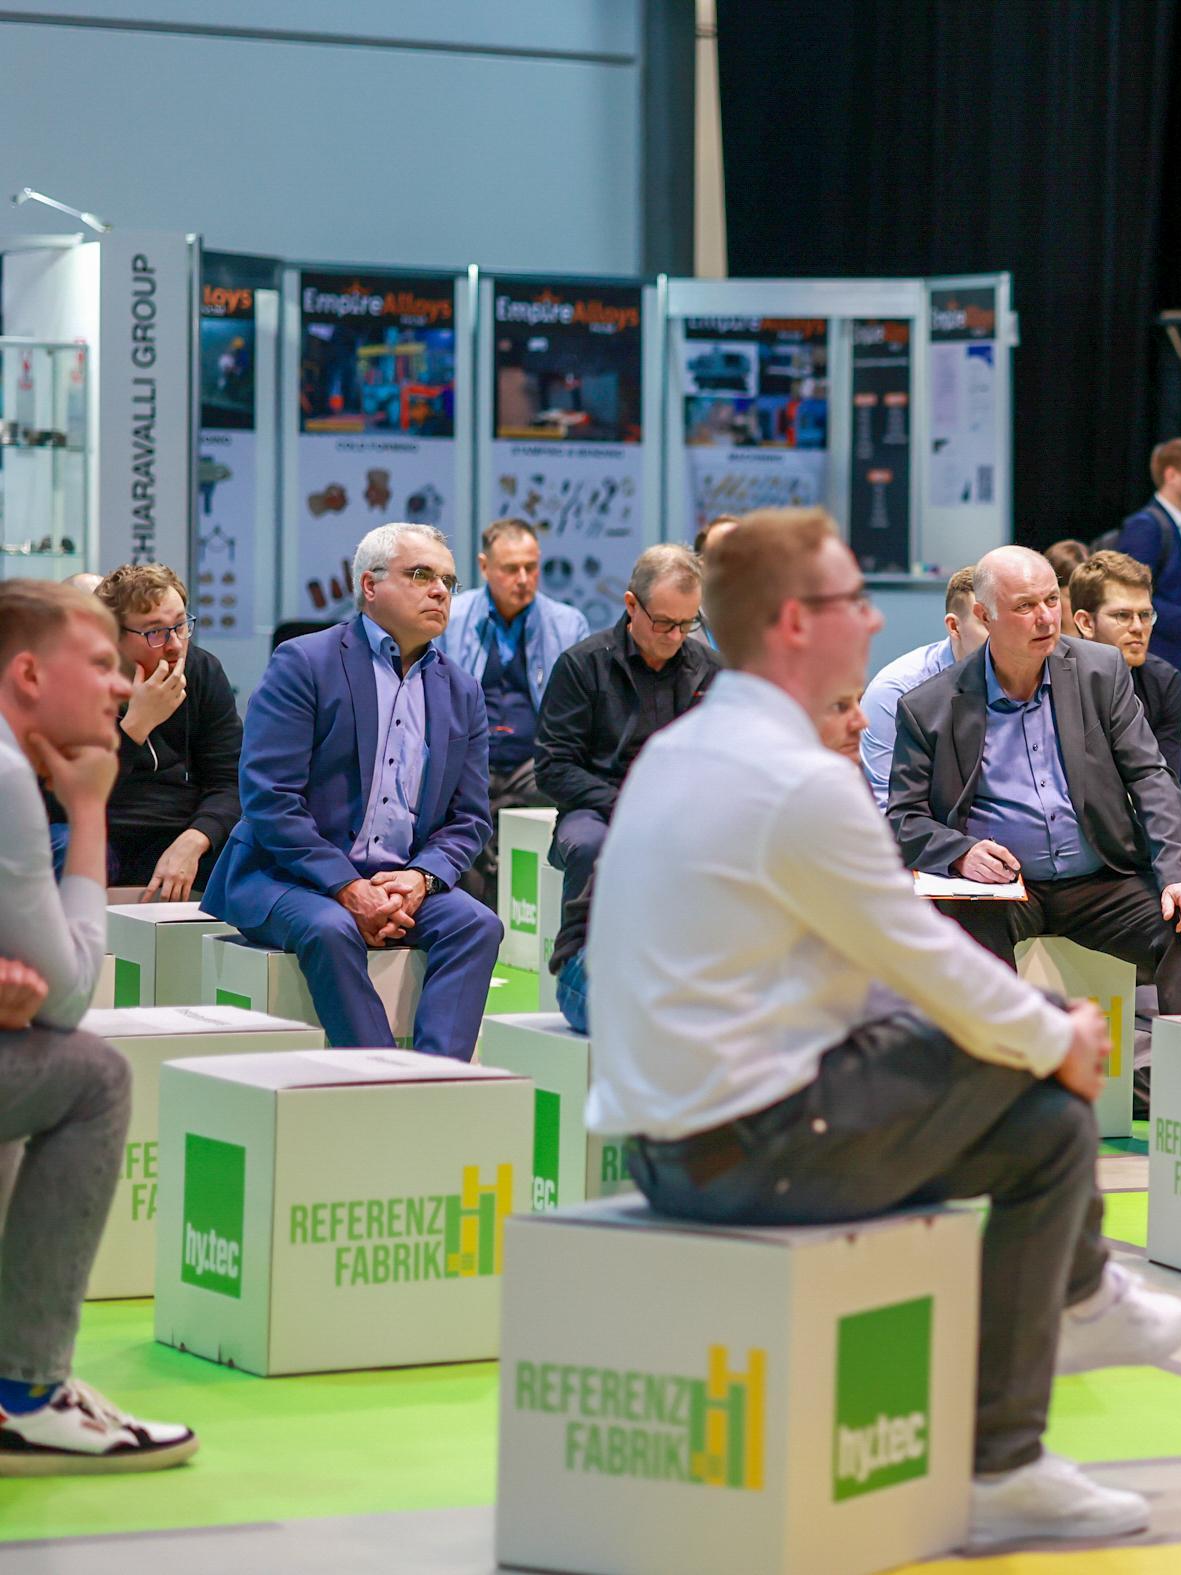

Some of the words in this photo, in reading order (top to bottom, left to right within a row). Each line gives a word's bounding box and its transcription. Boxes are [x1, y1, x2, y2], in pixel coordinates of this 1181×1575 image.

[132, 253, 156, 369] GROUP
[290, 1195, 444, 1244] REFERENZ
[185, 1222, 239, 1279] hy.tec
[335, 1241, 442, 1287] FABRIK
[515, 1360, 690, 1427] REFERENZ
[565, 1421, 689, 1481] FABRIK
[840, 1411, 925, 1482] hy.tec
